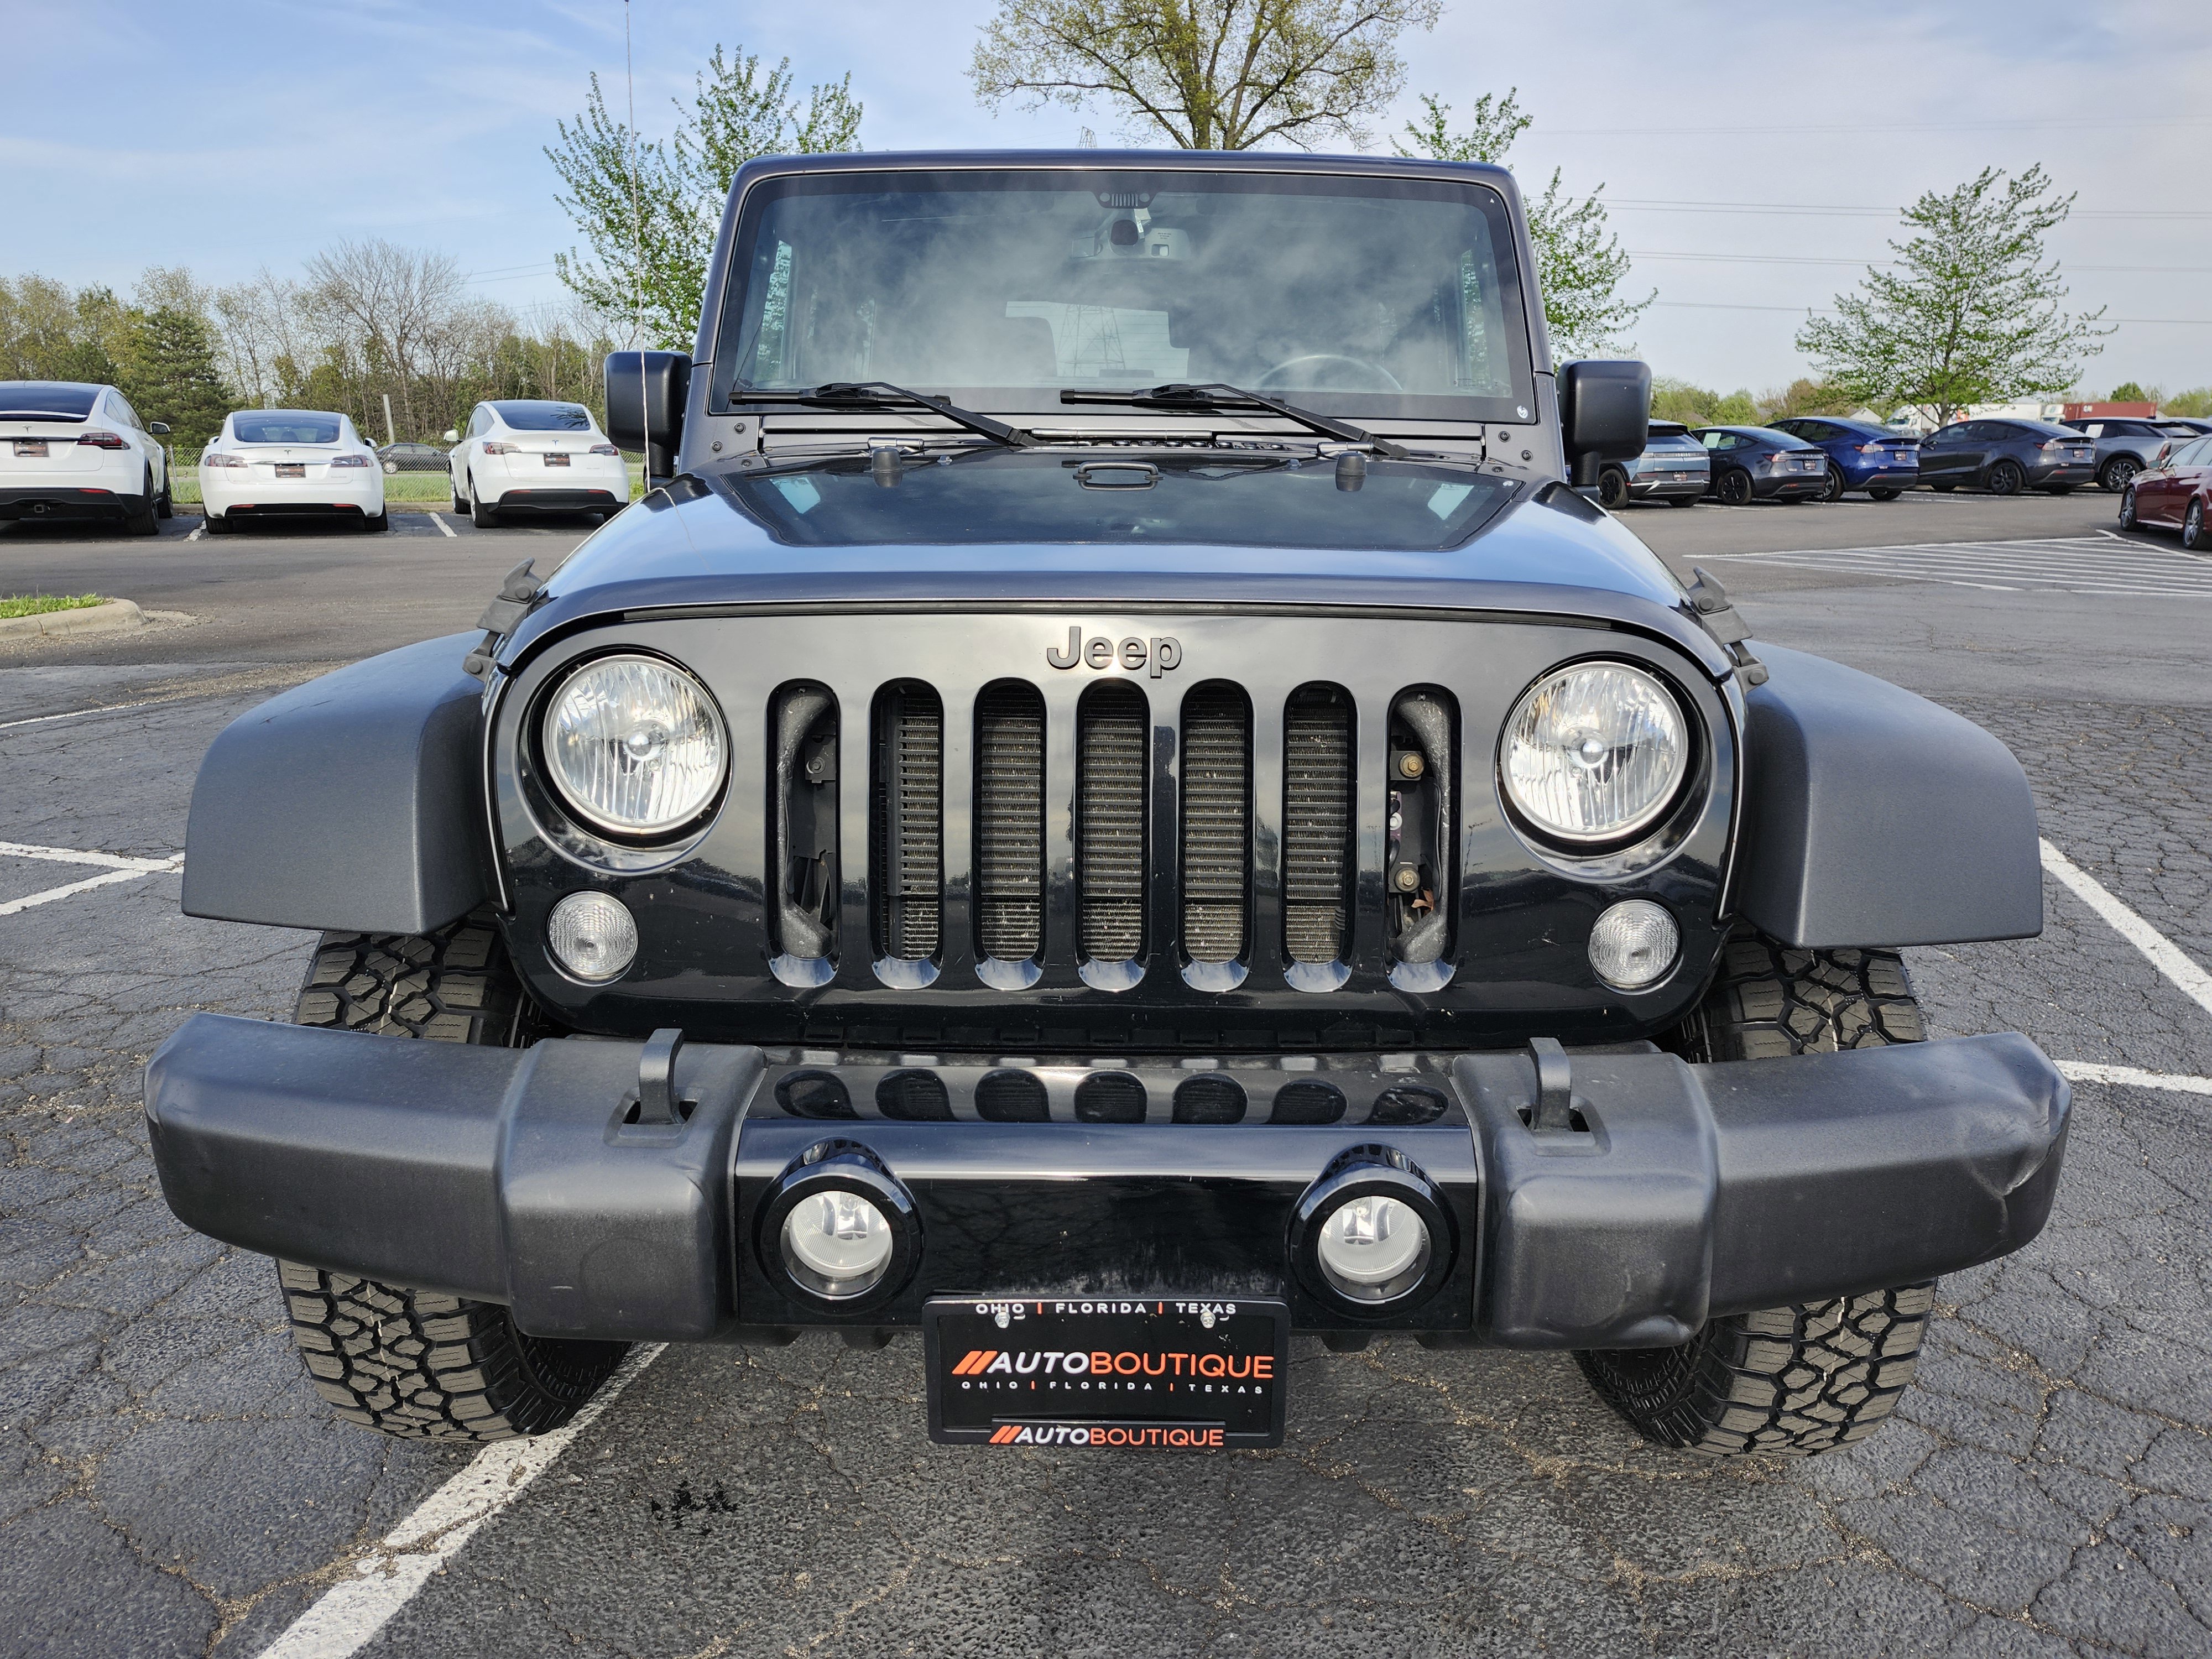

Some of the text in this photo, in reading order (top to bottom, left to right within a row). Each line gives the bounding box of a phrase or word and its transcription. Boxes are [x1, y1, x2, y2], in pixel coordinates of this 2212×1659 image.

[1046, 626, 1182, 679] Jeep
[975, 1302, 1237, 1314] OHIO FLORIDA TEXAS
[987, 1351, 1274, 1379] AUTOBOUTIQUE
[961, 1381, 1262, 1394] OHIO FLORIDA TEXAS
[1014, 1427, 1224, 1446] AUTOBOUTIQUE
